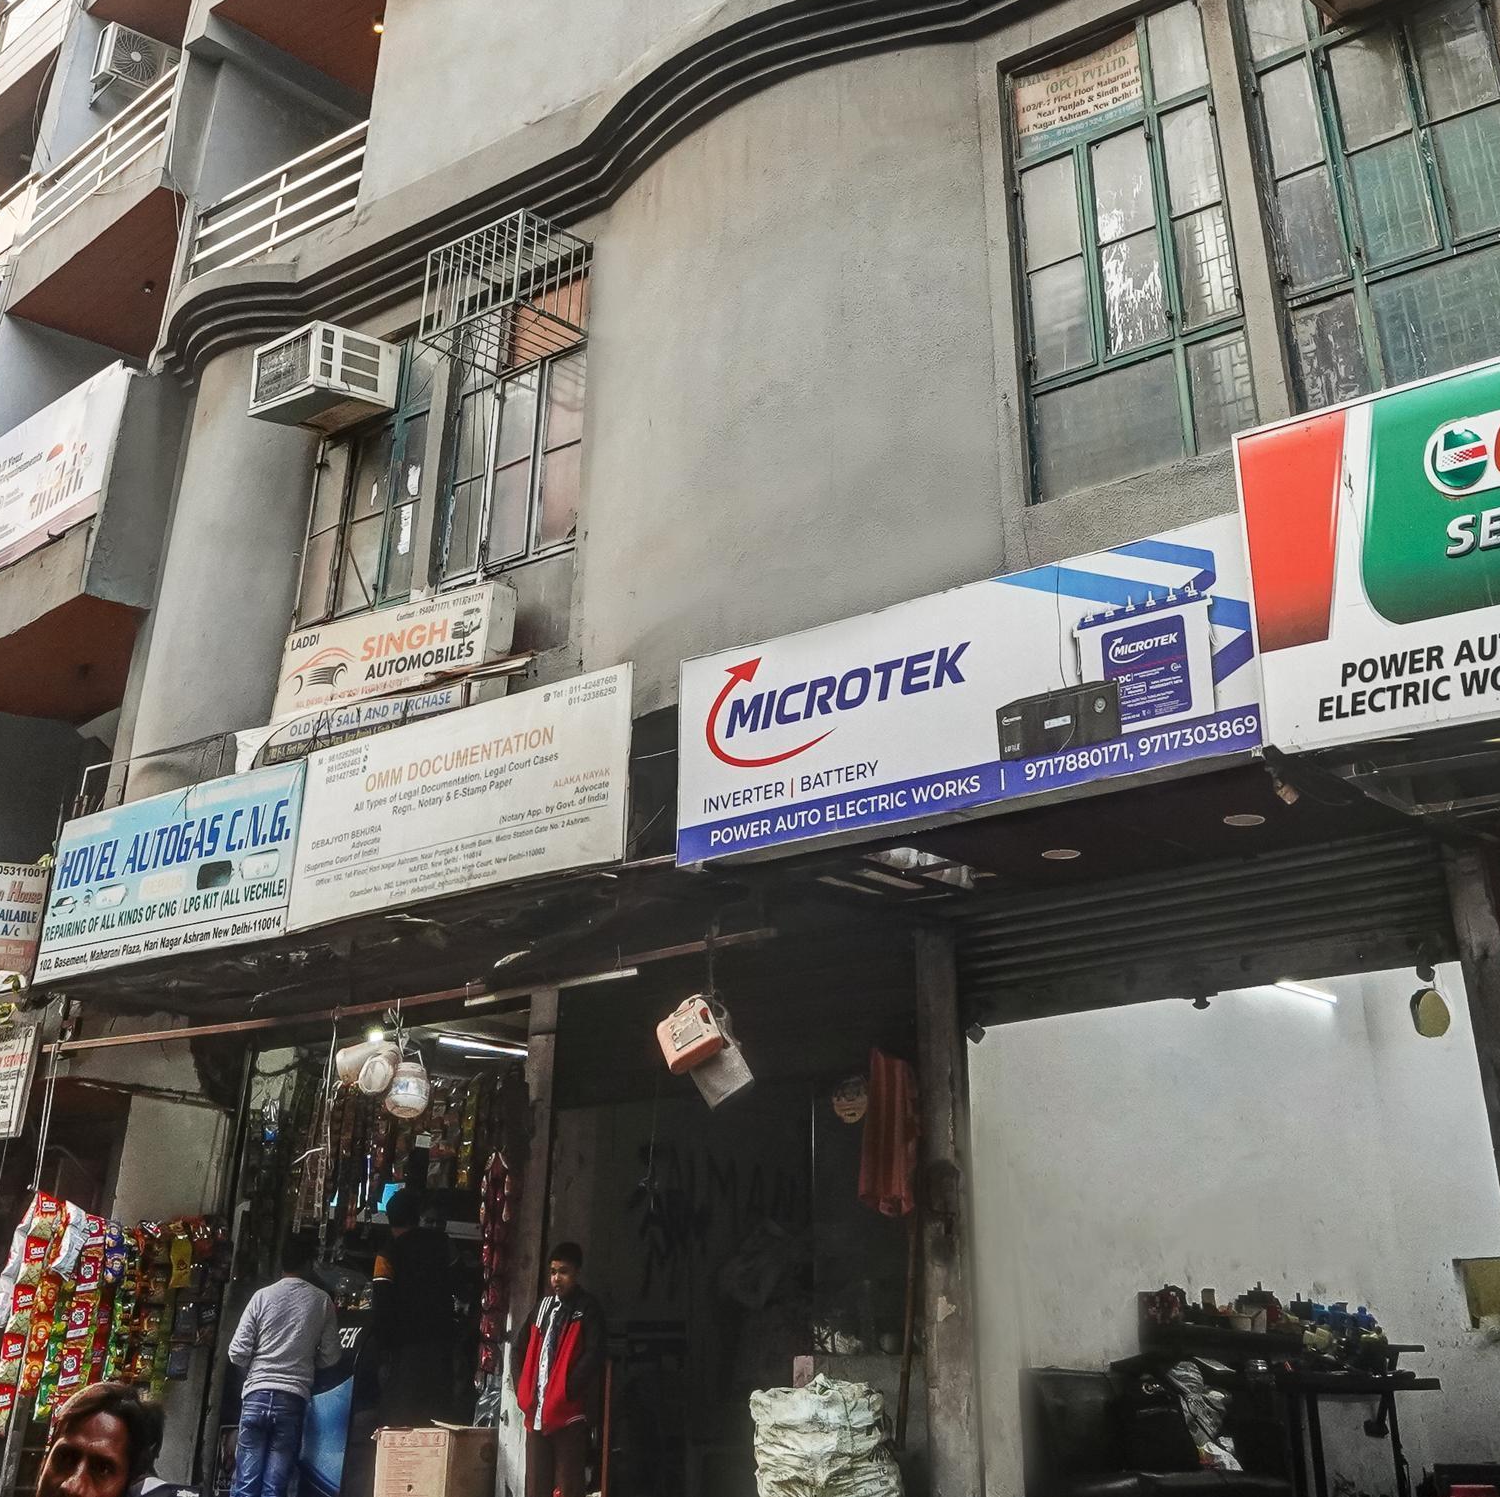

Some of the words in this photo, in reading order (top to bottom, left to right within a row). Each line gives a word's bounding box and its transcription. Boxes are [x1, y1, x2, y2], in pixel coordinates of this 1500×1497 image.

[1037, 109, 1055, 119] Near
[1058, 98, 1085, 114] Punjab
[1097, 87, 1118, 98] Sindh
[1121, 78, 1140, 88] Bank
[1046, 77, 1078, 96] (OPC)
[1054, 93, 1071, 103] First
[1074, 85, 1094, 96] Floor
[1097, 70, 1132, 88] Maharani
[1032, 121, 1056, 131] Nagar
[1059, 109, 1091, 123] Ashram,
[1093, 101, 1109, 110] New
[291, 633, 320, 651] LADDI
[360, 618, 448, 662] SINGH
[364, 640, 475, 681] AUTOMOBILES
[1114, 632, 1178, 658] MICROTEK
[1340, 645, 1444, 687] POWER
[725, 641, 972, 739] MICROTEK
[1318, 675, 1451, 722] ELECTRIC
[290, 725, 308, 737] OLD
[364, 704, 389, 722] AND
[392, 691, 452, 715] PURCHASE
[365, 772, 404, 793] OMM
[407, 725, 555, 783] DOCUMENTATION
[1024, 742, 1134, 781] 9717880171,
[1138, 715, 1258, 755] 9717303869
[365, 796, 387, 811] Types
[398, 786, 420, 802] Legal
[483, 766, 506, 781] Legal
[508, 760, 532, 775] Court
[533, 751, 560, 768] Cases
[417, 794, 444, 811] Notary
[453, 783, 488, 801] E-Stamp
[488, 778, 513, 793] Paper
[553, 773, 581, 789] ALAKA
[582, 767, 610, 781] NAYAK
[574, 781, 610, 795] Advocate
[703, 781, 785, 814] INVERTER
[800, 760, 879, 792] BATTERY
[498, 812, 525, 825] (Notary
[556, 800, 577, 810] Govt.
[587, 792, 609, 803] India)
[710, 819, 771, 846] POWER
[778, 808, 821, 832] AUTO
[825, 791, 907, 822] ELECTRIC
[911, 775, 981, 804] WORKS
[57, 839, 119, 891] HOVEL
[122, 814, 224, 876] AUTOGAS
[225, 799, 291, 853] C.N.G.
[351, 824, 382, 840] BEHURIA
[351, 837, 381, 849] Advocate
[334, 855, 353, 864] Court
[1, 924, 21, 937] A/c
[43, 918, 86, 942] REPAIRING
[87, 916, 99, 931] OF
[100, 911, 117, 929] ALL
[118, 905, 145, 927] KINDS
[145, 902, 157, 918] OF
[158, 898, 178, 916] CNG
[183, 895, 202, 914] LPG
[202, 891, 220, 910] KIT
[220, 886, 241, 911] (ALL
[242, 878, 287, 901] VECHILE)
[54, 952, 89, 969] Basement,
[89, 945, 121, 963] Maharani
[121, 944, 143, 956] Plaza,
[143, 940, 159, 952] Hari
[160, 935, 181, 950] Nagar
[182, 929, 211, 944] Ashram
[212, 927, 229, 939] New
[230, 915, 282, 936] Delhi-110014
